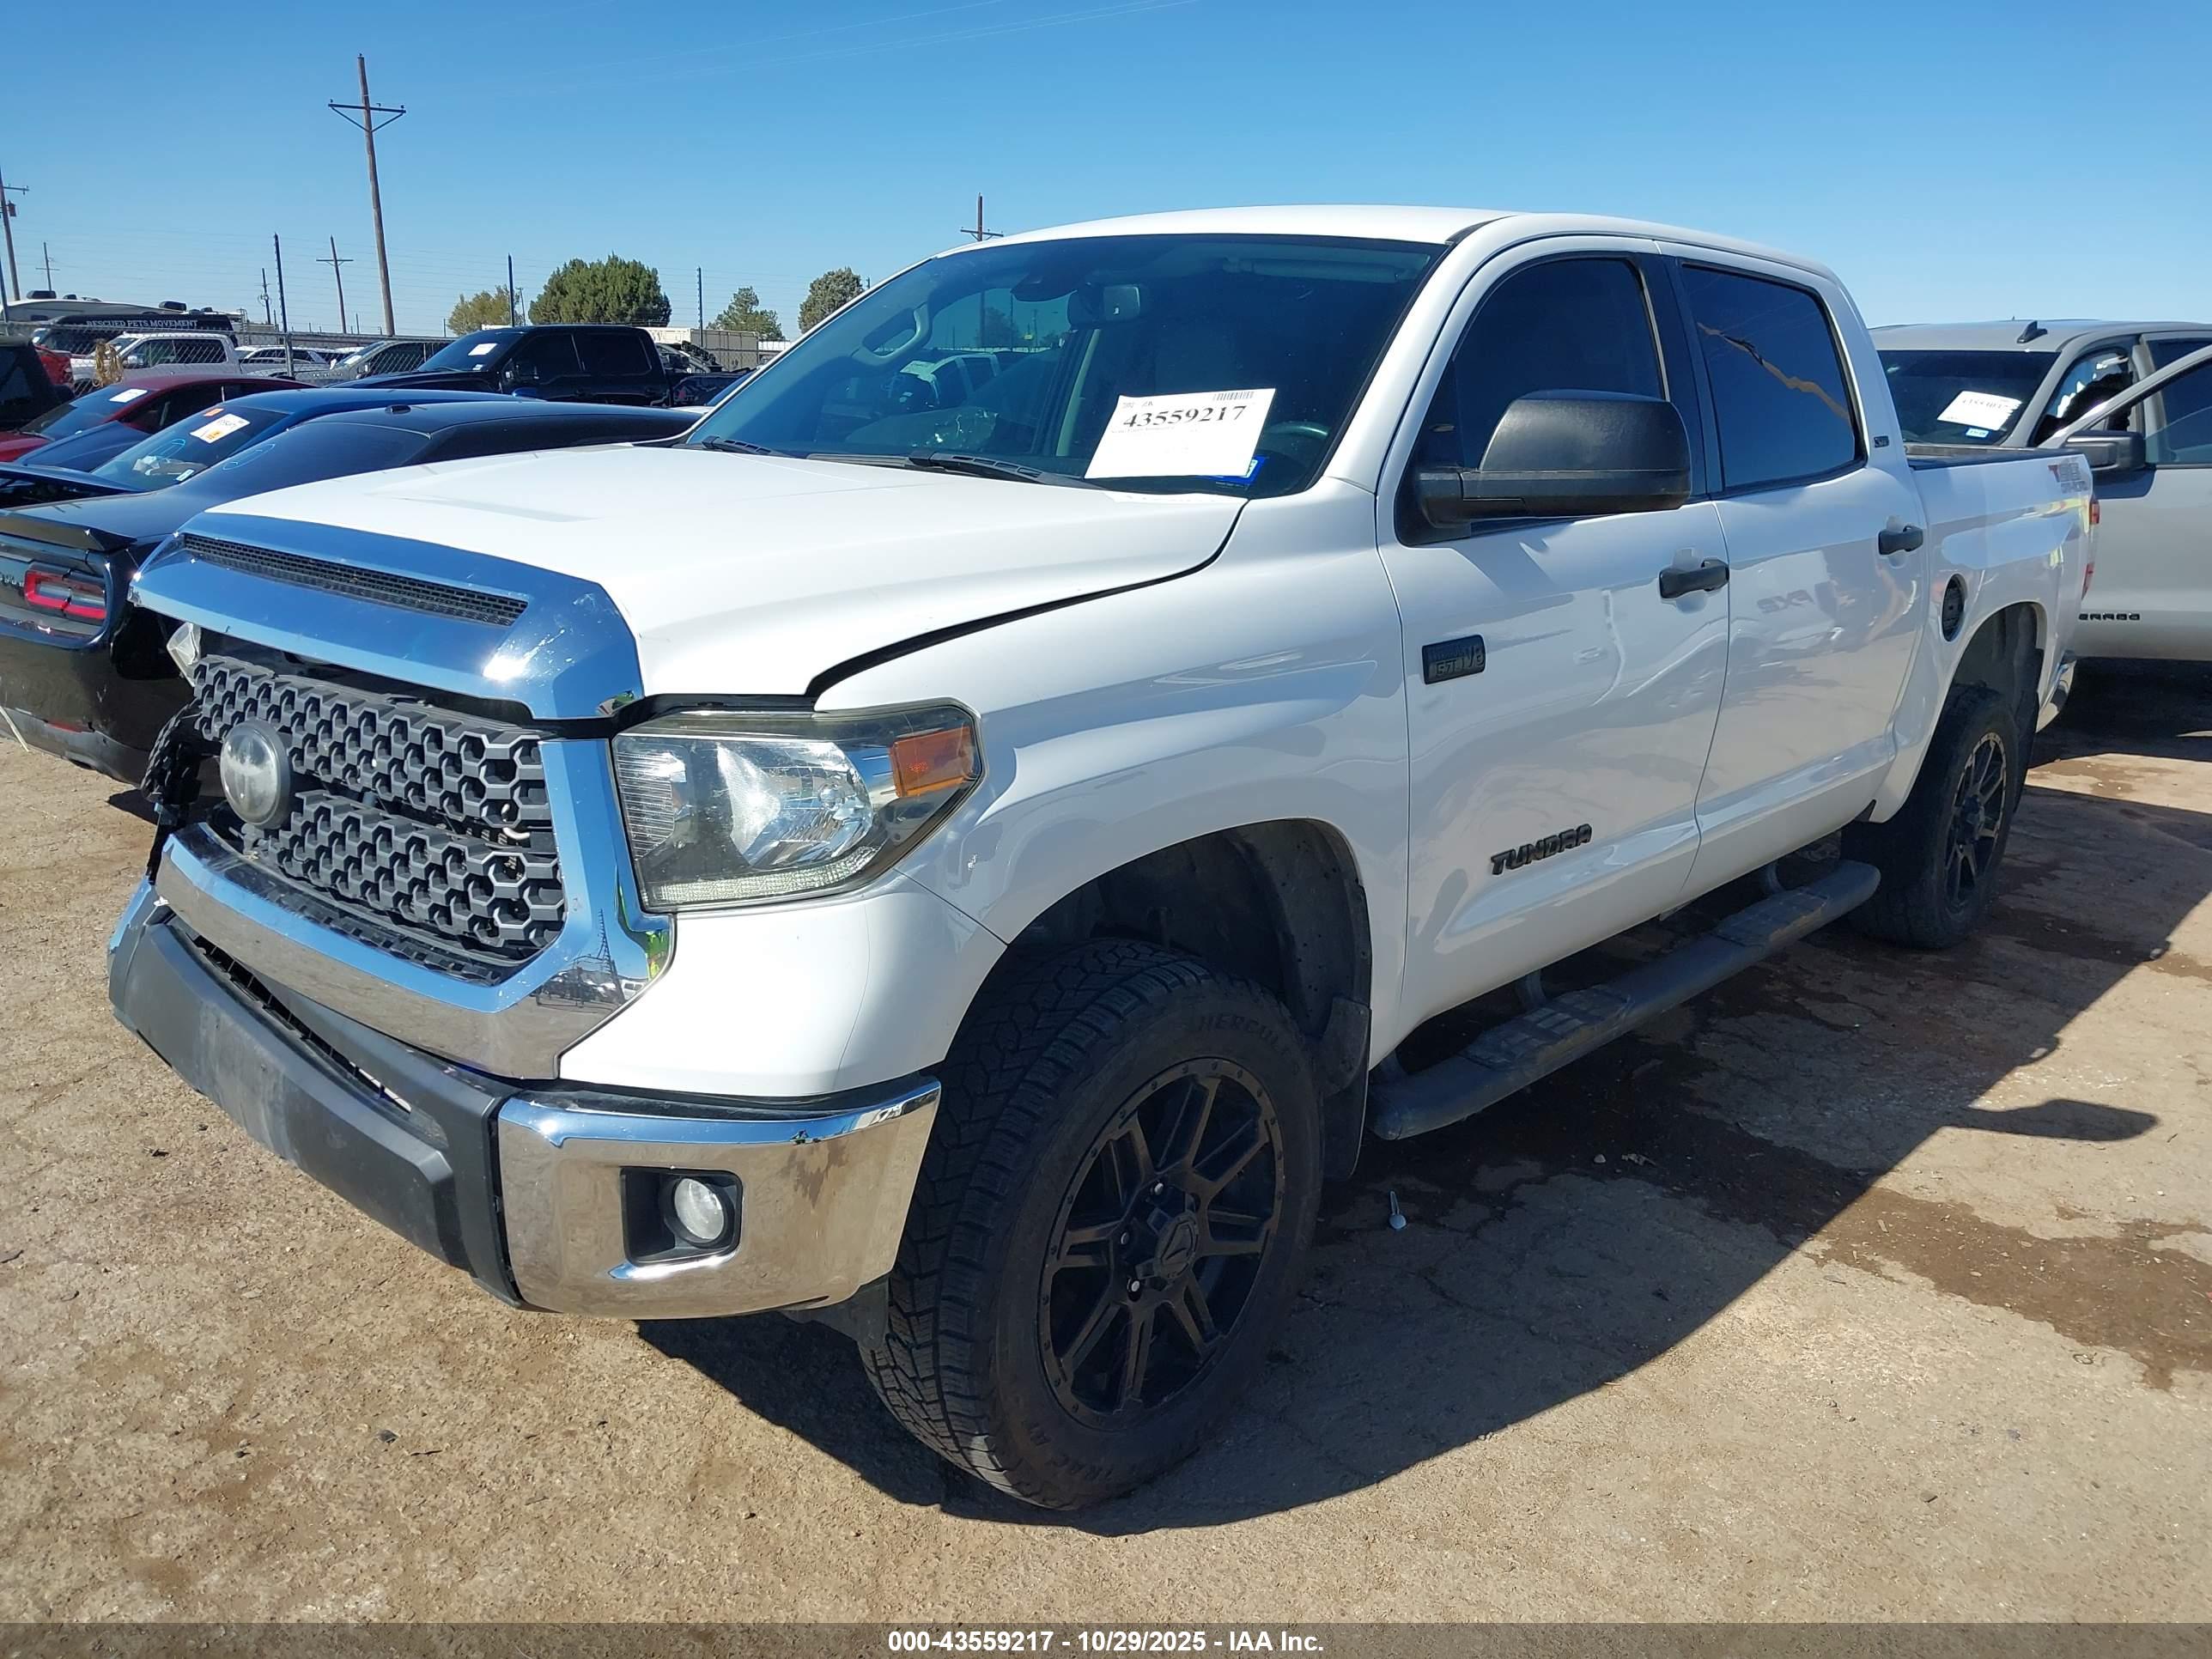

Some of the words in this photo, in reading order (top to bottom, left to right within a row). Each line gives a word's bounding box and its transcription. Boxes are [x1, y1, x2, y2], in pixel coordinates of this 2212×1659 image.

[86, 319, 126, 328] RESCUED
[126, 319, 149, 328] PETS
[149, 319, 198, 328] MOVEMENT
[1122, 404, 1248, 428] 43559217
[1491, 823, 1593, 876] TUNDRA
